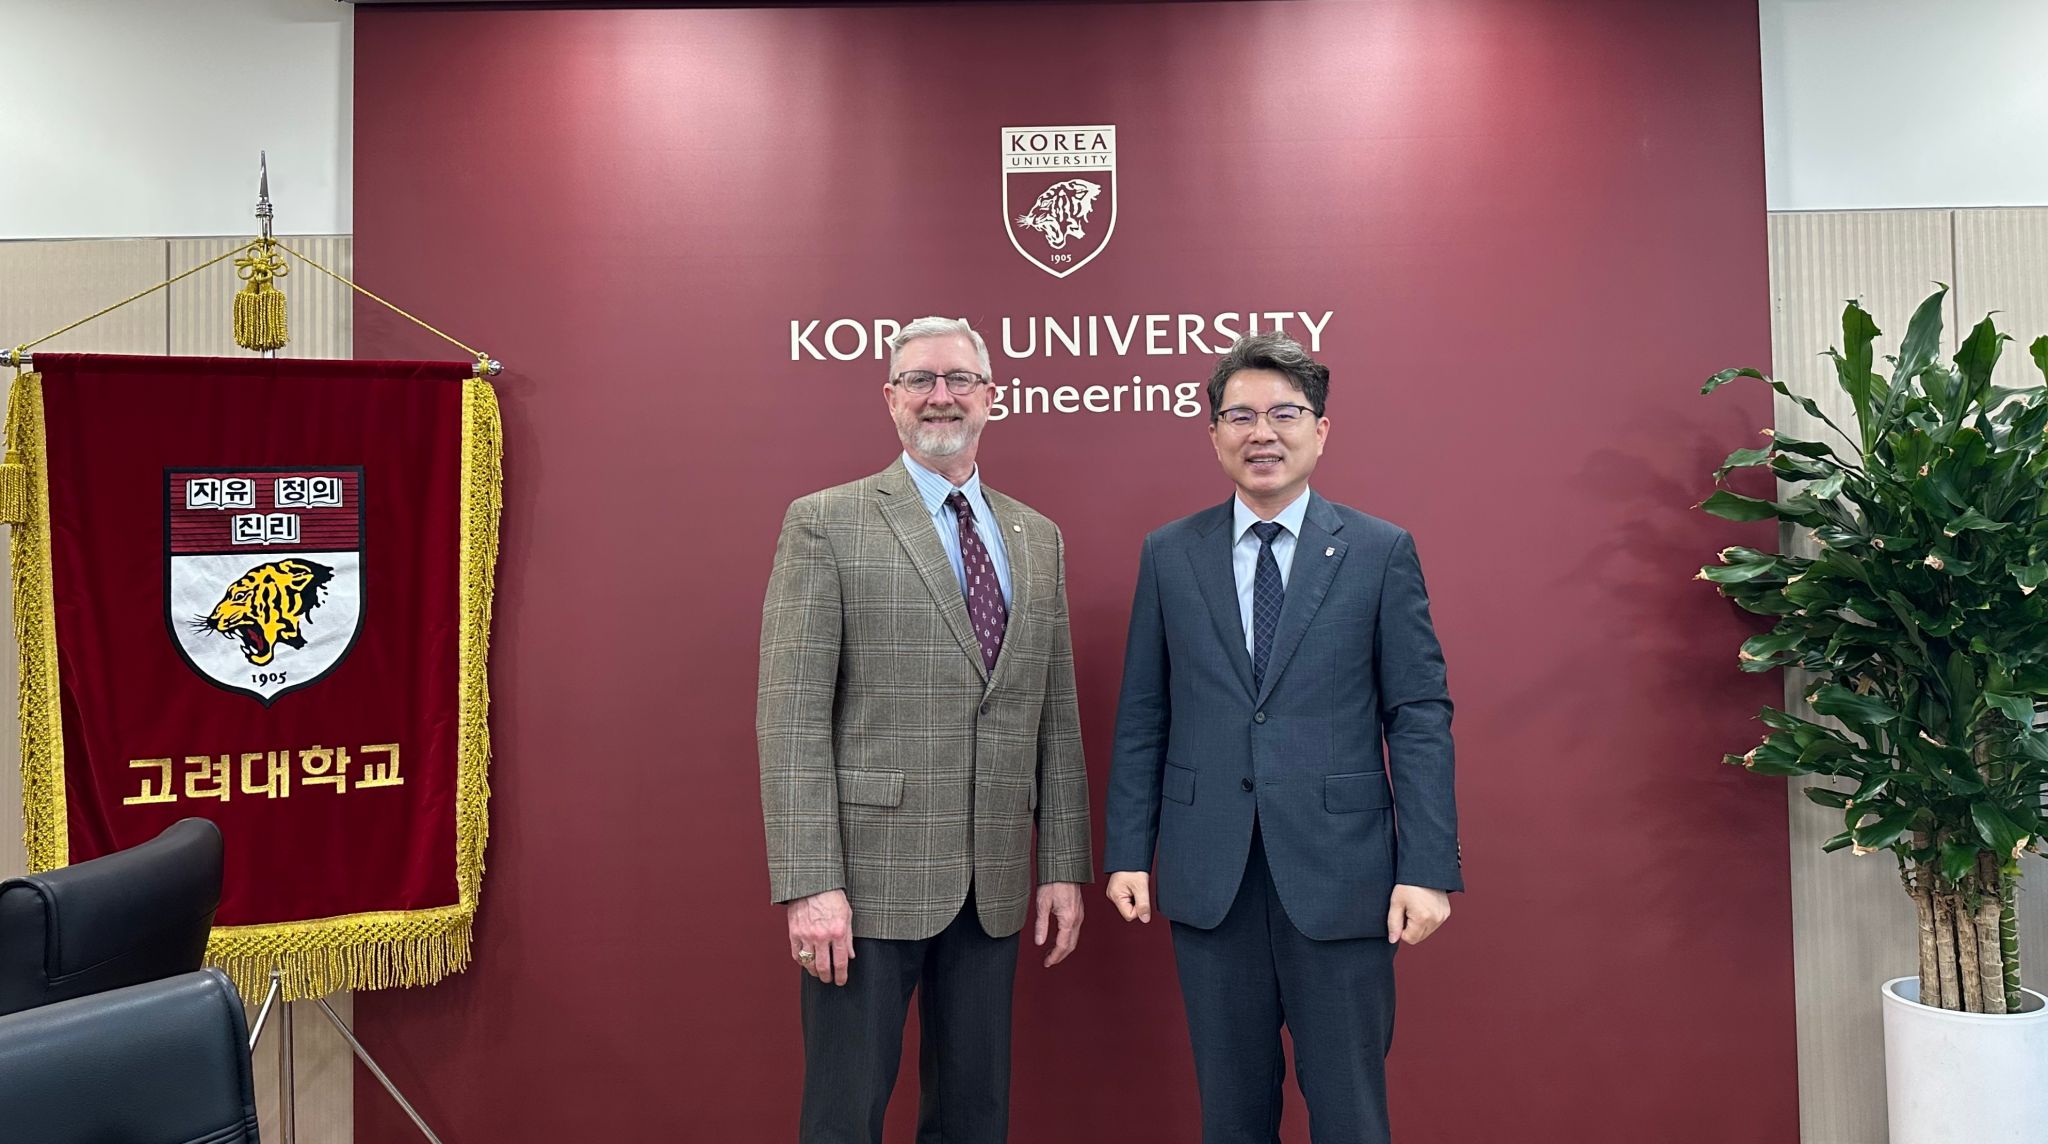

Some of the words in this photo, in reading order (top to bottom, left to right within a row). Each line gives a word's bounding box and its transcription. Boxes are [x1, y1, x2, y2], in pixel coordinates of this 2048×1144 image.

[1011, 132, 1108, 152] KOREA
[1012, 155, 1108, 166] UNIVERSITY
[1050, 253, 1072, 264] 1905
[790, 317, 973, 361] KOR
[1002, 310, 1335, 359] UNIVERSITY
[987, 375, 1202, 420] gineering
[194, 480, 249, 501] 자유
[282, 479, 335, 501] 정의
[239, 517, 292, 537] 진리
[251, 671, 288, 687] 1905
[123, 742, 405, 805] 고려대학교
